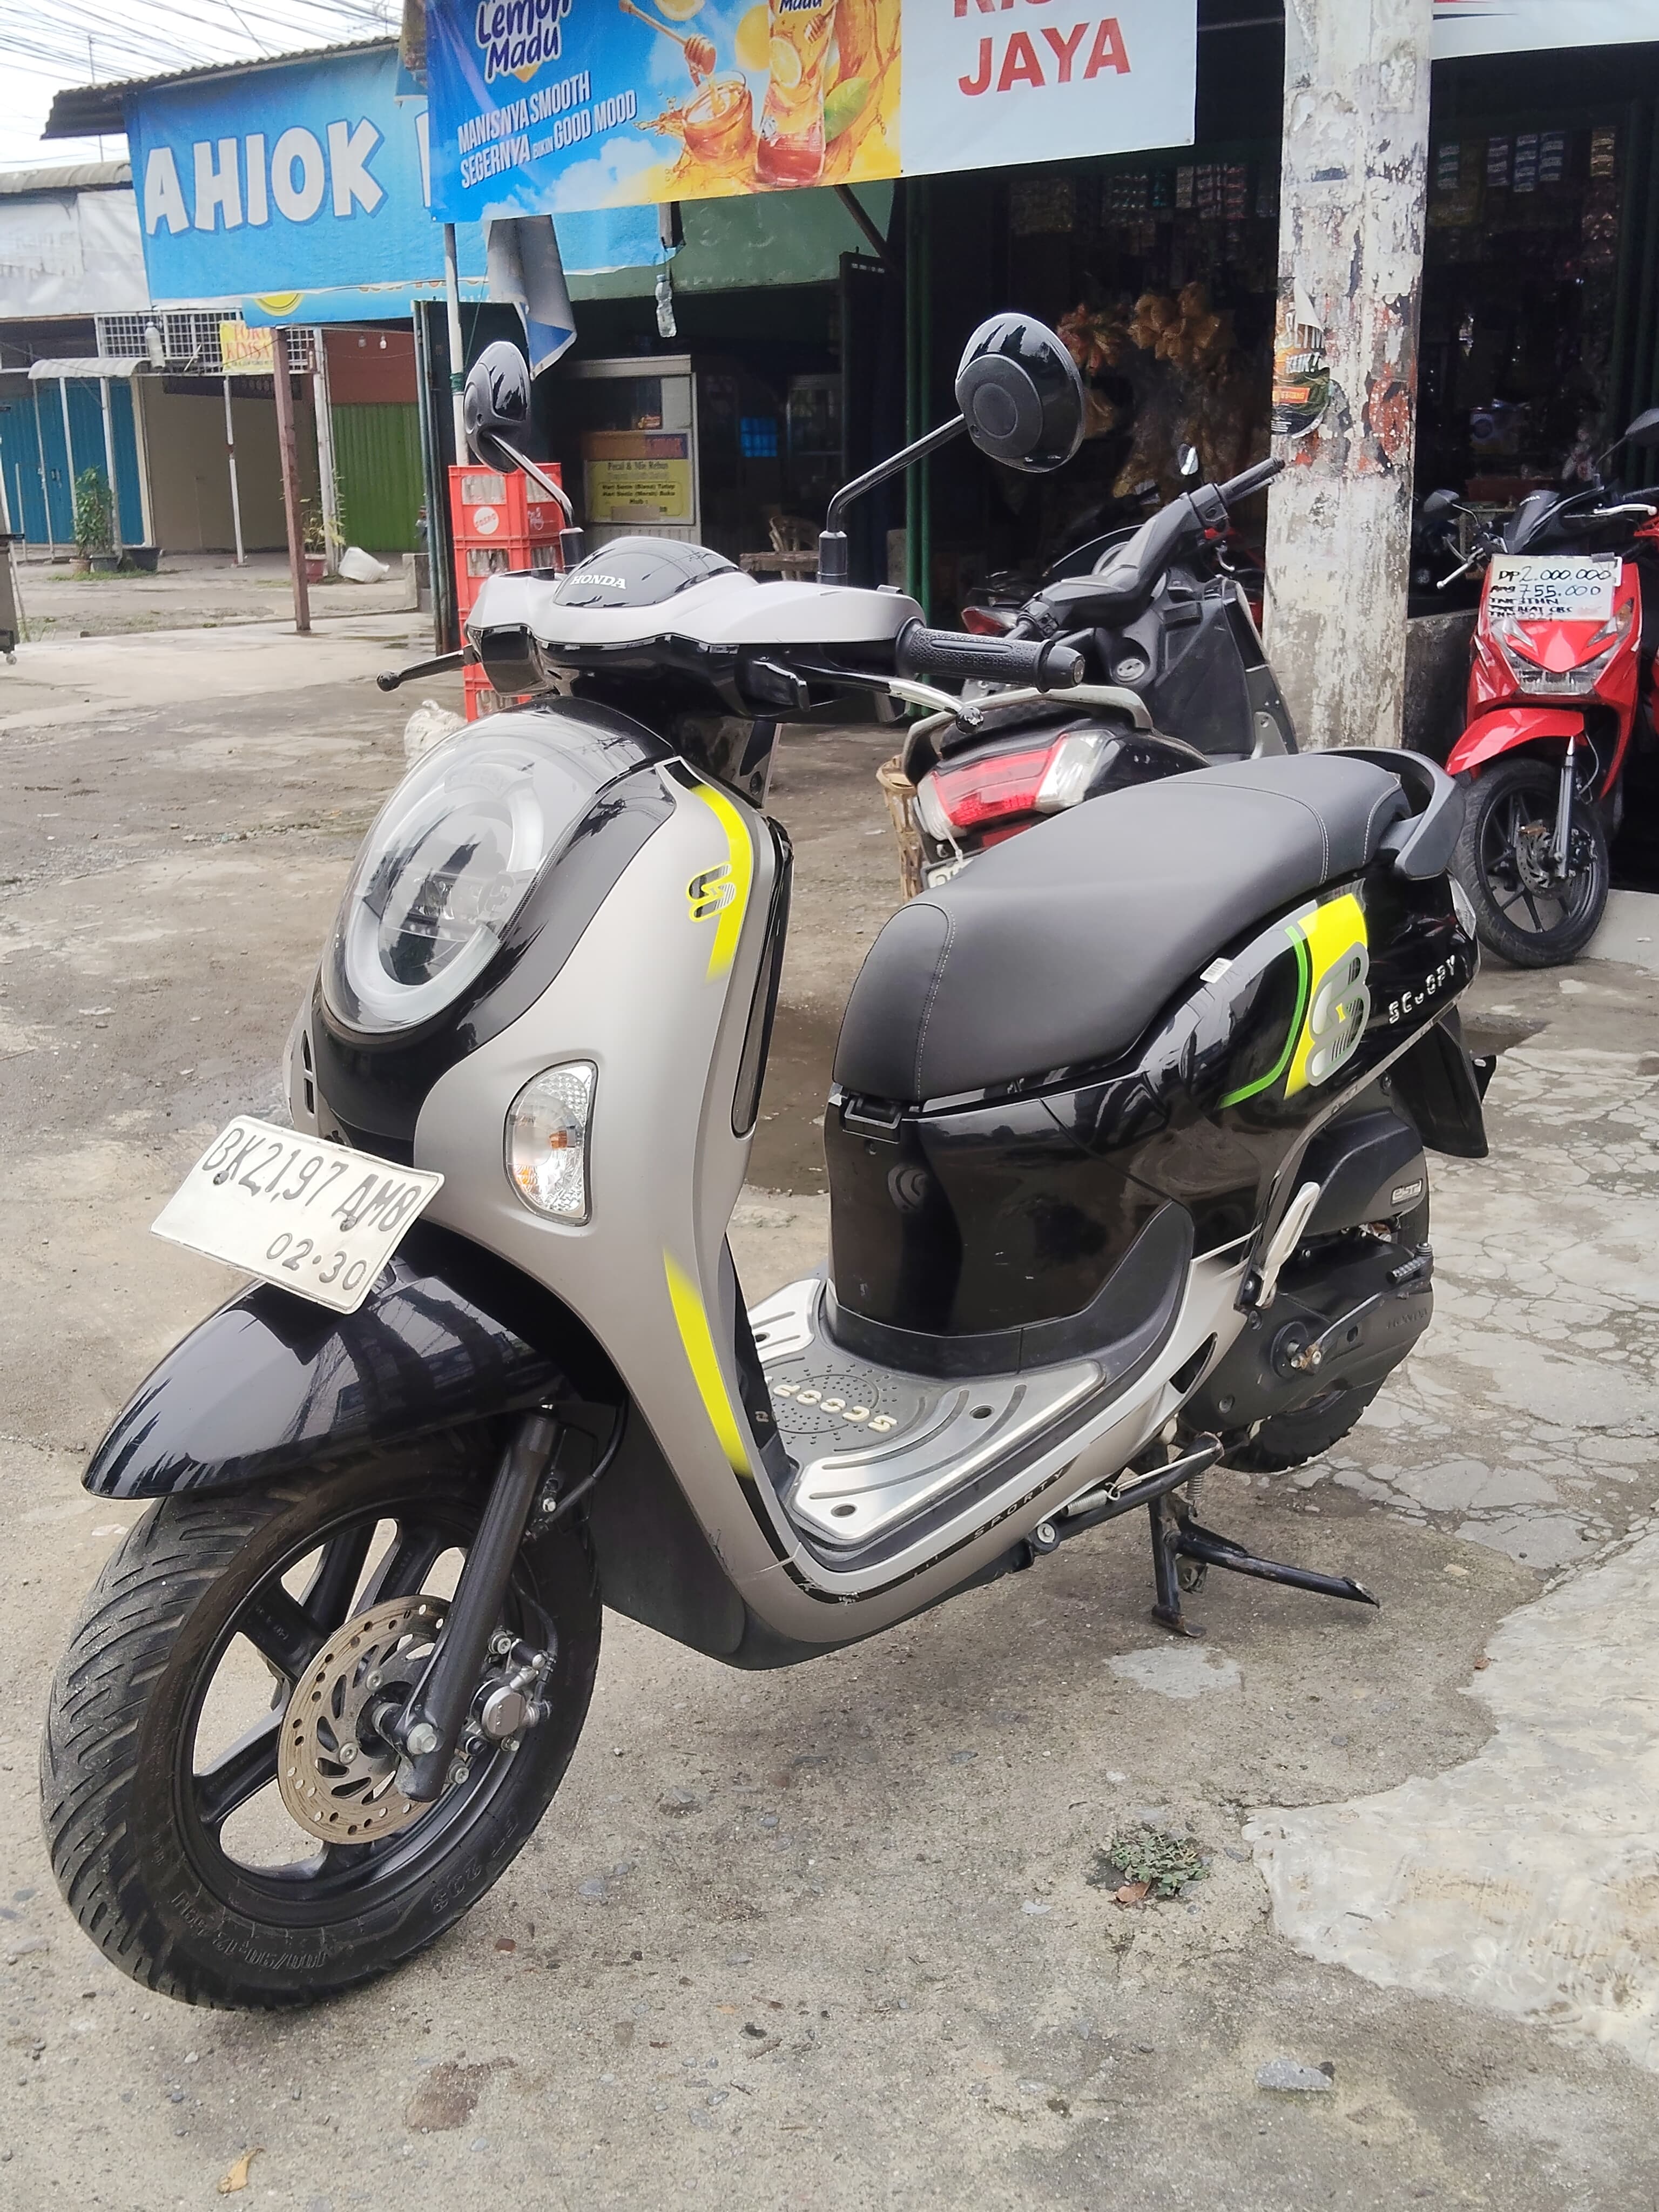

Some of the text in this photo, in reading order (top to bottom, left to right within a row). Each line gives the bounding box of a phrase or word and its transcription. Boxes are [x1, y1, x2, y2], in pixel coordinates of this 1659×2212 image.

[488, 22, 558, 79] Madu
[958, 18, 1131, 96] JAYA
[457, 70, 591, 154] MANISNYA SMOOTH
[461, 134, 531, 189] SEGERNYA
[532, 137, 554, 159] BIKIN
[553, 109, 591, 151] GOOD
[594, 90, 636, 133] MOOD
[144, 117, 384, 235] AHIOK
[570, 574, 626, 590] HONDA
[1499, 566, 1611, 583] DP 2.000.000
[1520, 584, 1601, 599] 755.000
[765, 1376, 899, 1435] SCOOP
[973, 1468, 1064, 1539] SPORTY
